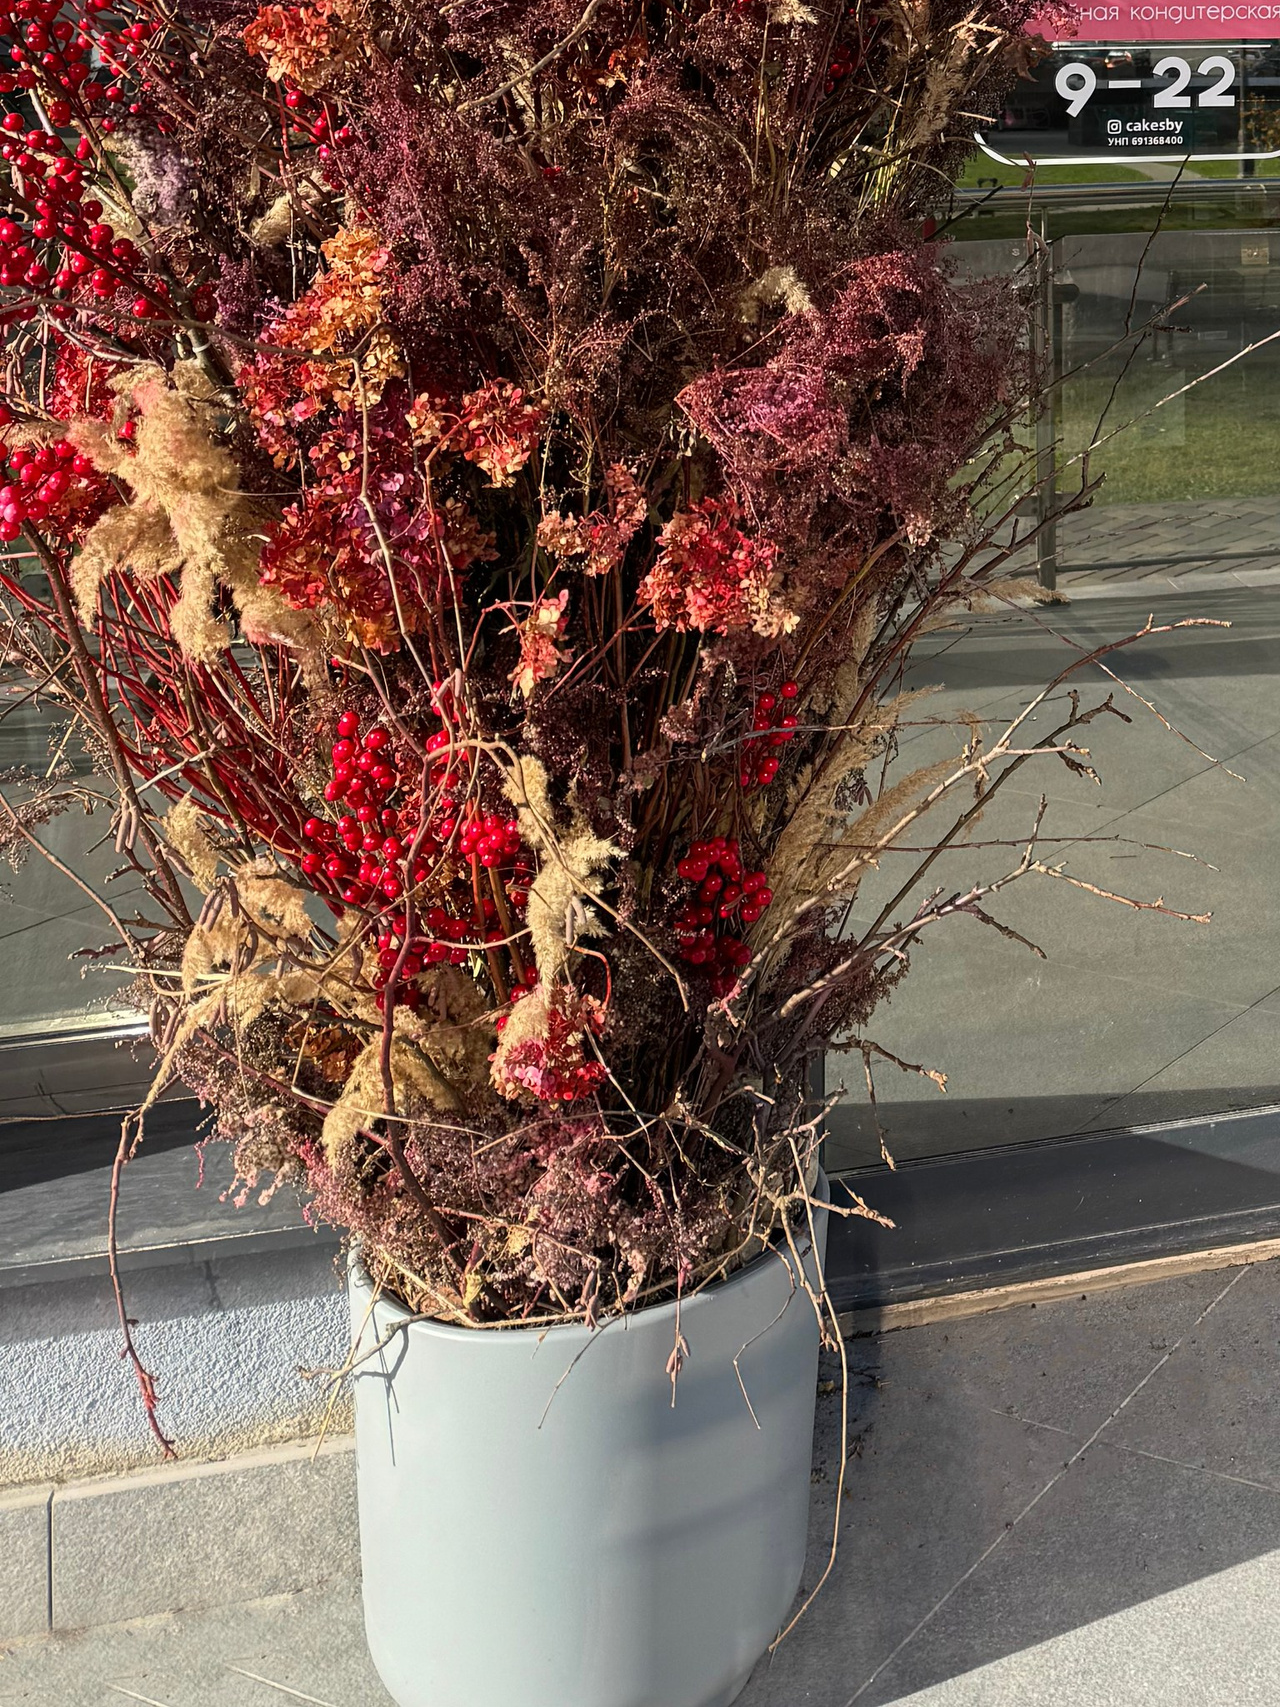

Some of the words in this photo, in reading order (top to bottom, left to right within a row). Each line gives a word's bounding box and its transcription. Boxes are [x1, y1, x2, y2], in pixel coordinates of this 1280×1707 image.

[1126, 118, 1184, 133] cakesby
[1107, 136, 1129, 146] УНП
[1131, 135, 1184, 146] 691368400
